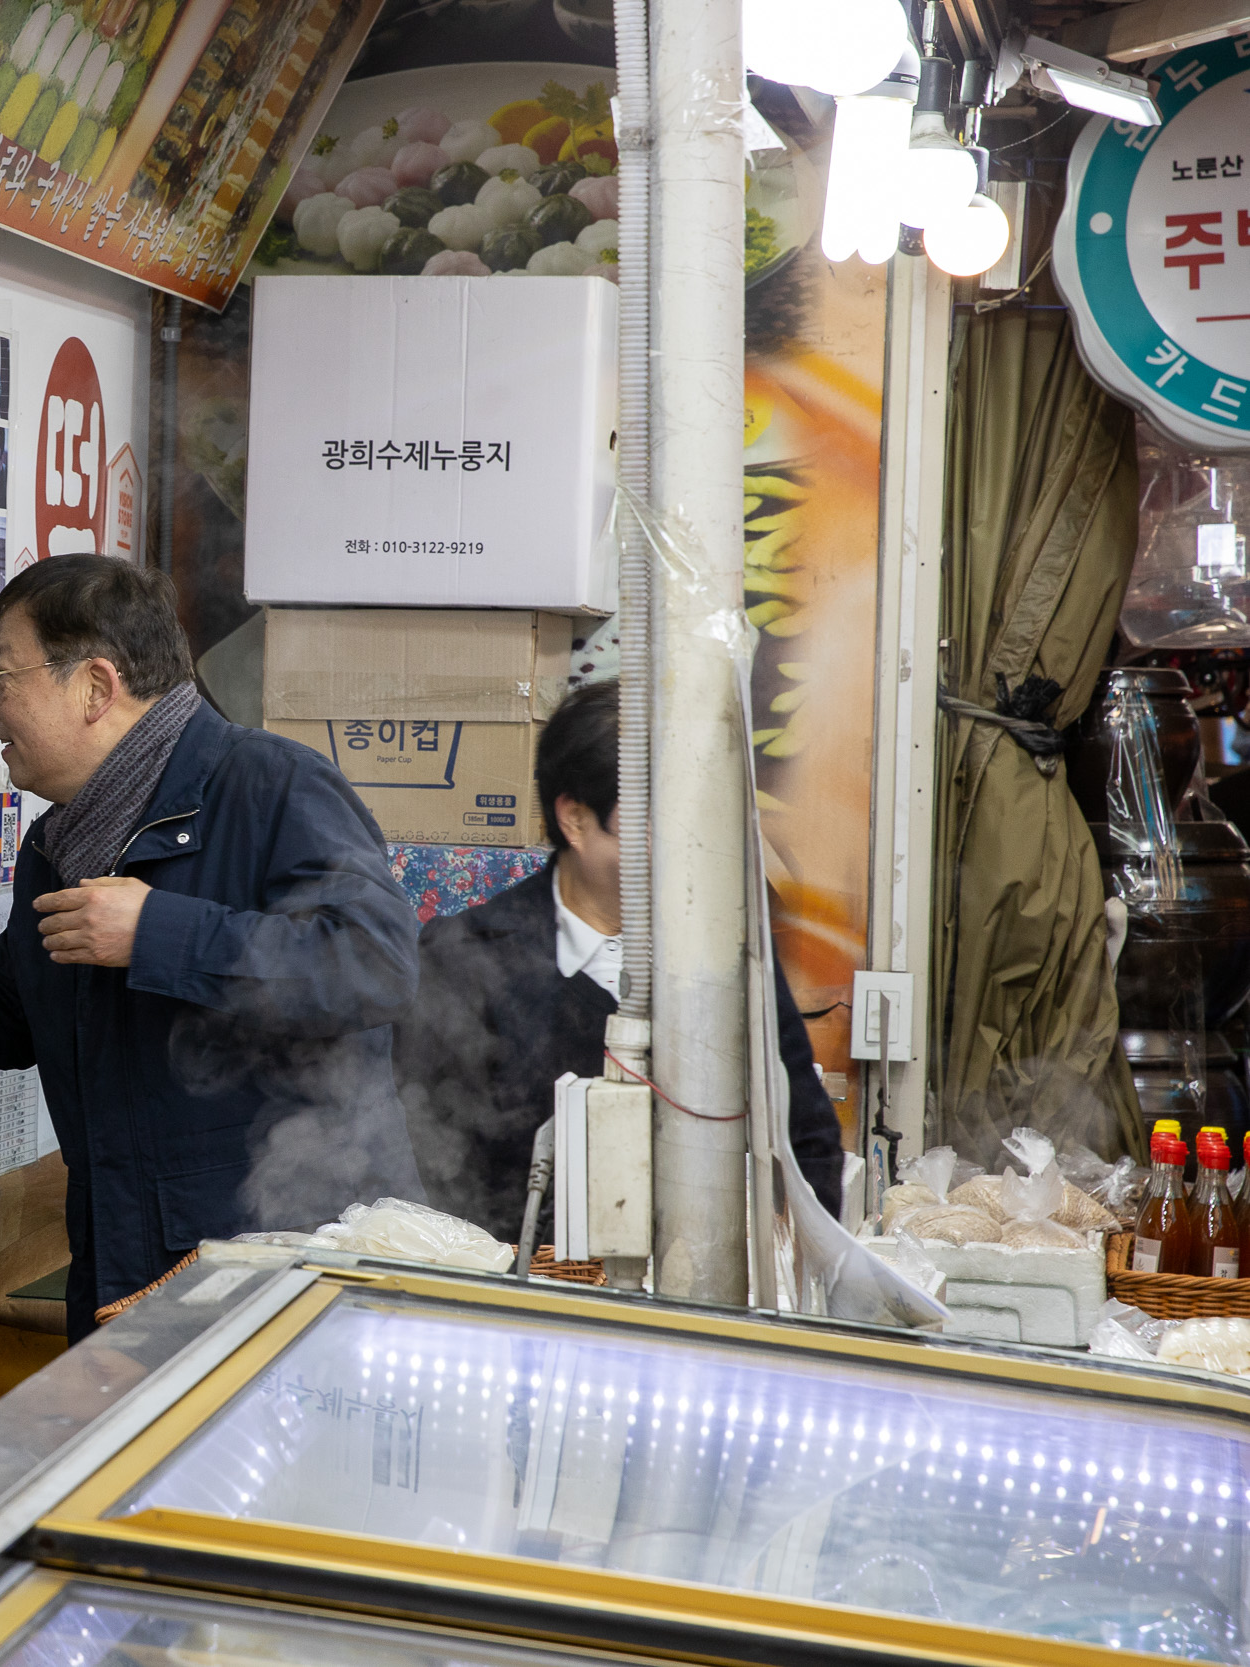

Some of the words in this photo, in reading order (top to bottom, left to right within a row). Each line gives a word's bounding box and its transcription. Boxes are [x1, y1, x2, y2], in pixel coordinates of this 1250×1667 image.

[1172, 155, 1244, 180] 노룬산
[30, 160, 92, 233] 국내산
[83, 186, 128, 248] 쌀을
[120, 200, 186, 264] 사용하고
[174, 224, 241, 296] 있습니다.
[1164, 209, 1250, 290] 주
[322, 439, 511, 472] 광희수제누룽지
[344, 539, 370, 555] 전화
[382, 540, 484, 555] 010-3122-9219
[344, 720, 439, 751] 종이컵
[376, 755, 396, 764] Paper
[398, 756, 412, 765] Cup
[480, 796, 511, 806] 위생용품
